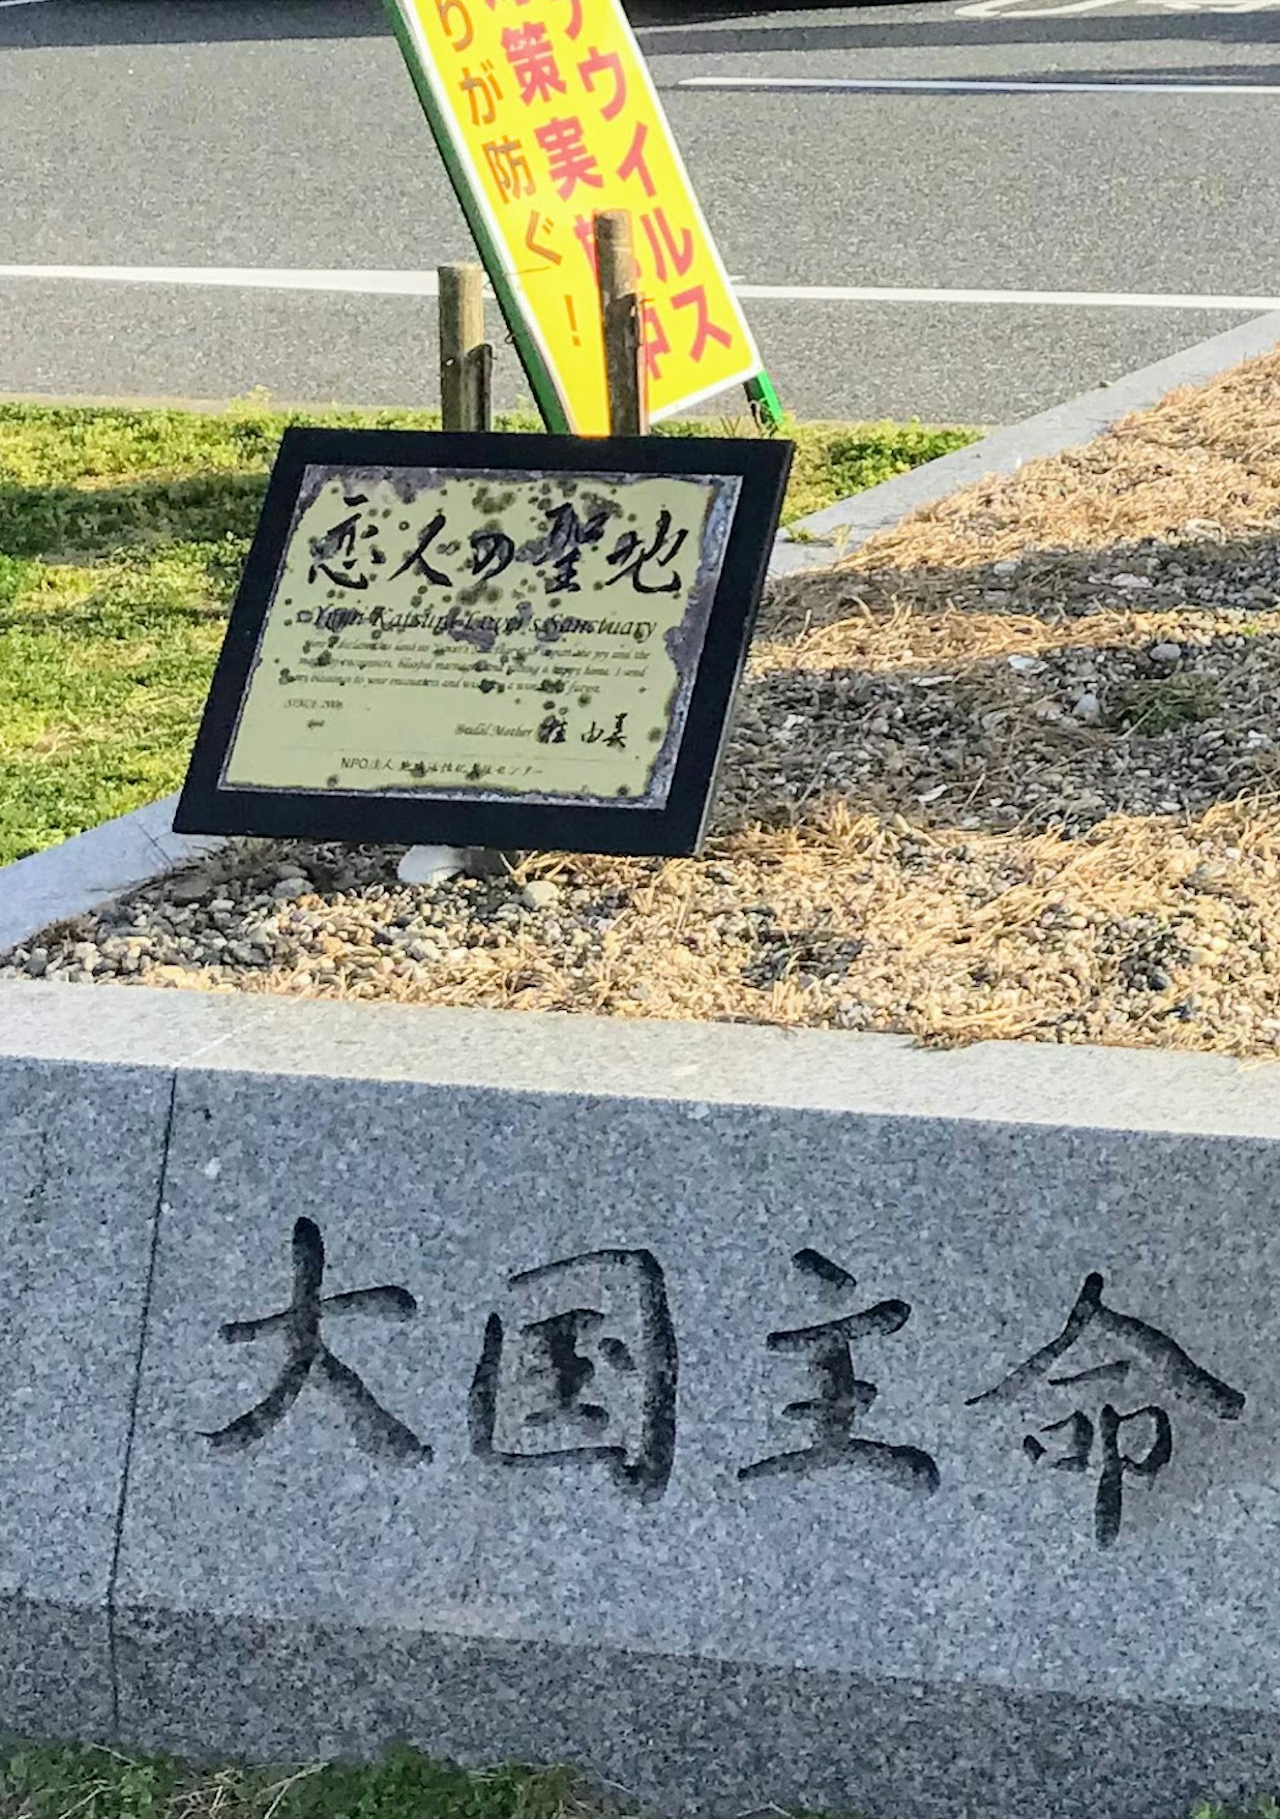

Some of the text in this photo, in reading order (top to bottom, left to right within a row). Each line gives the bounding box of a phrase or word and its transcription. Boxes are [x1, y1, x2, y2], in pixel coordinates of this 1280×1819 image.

[307, 492, 690, 595] 恋人の聖地
